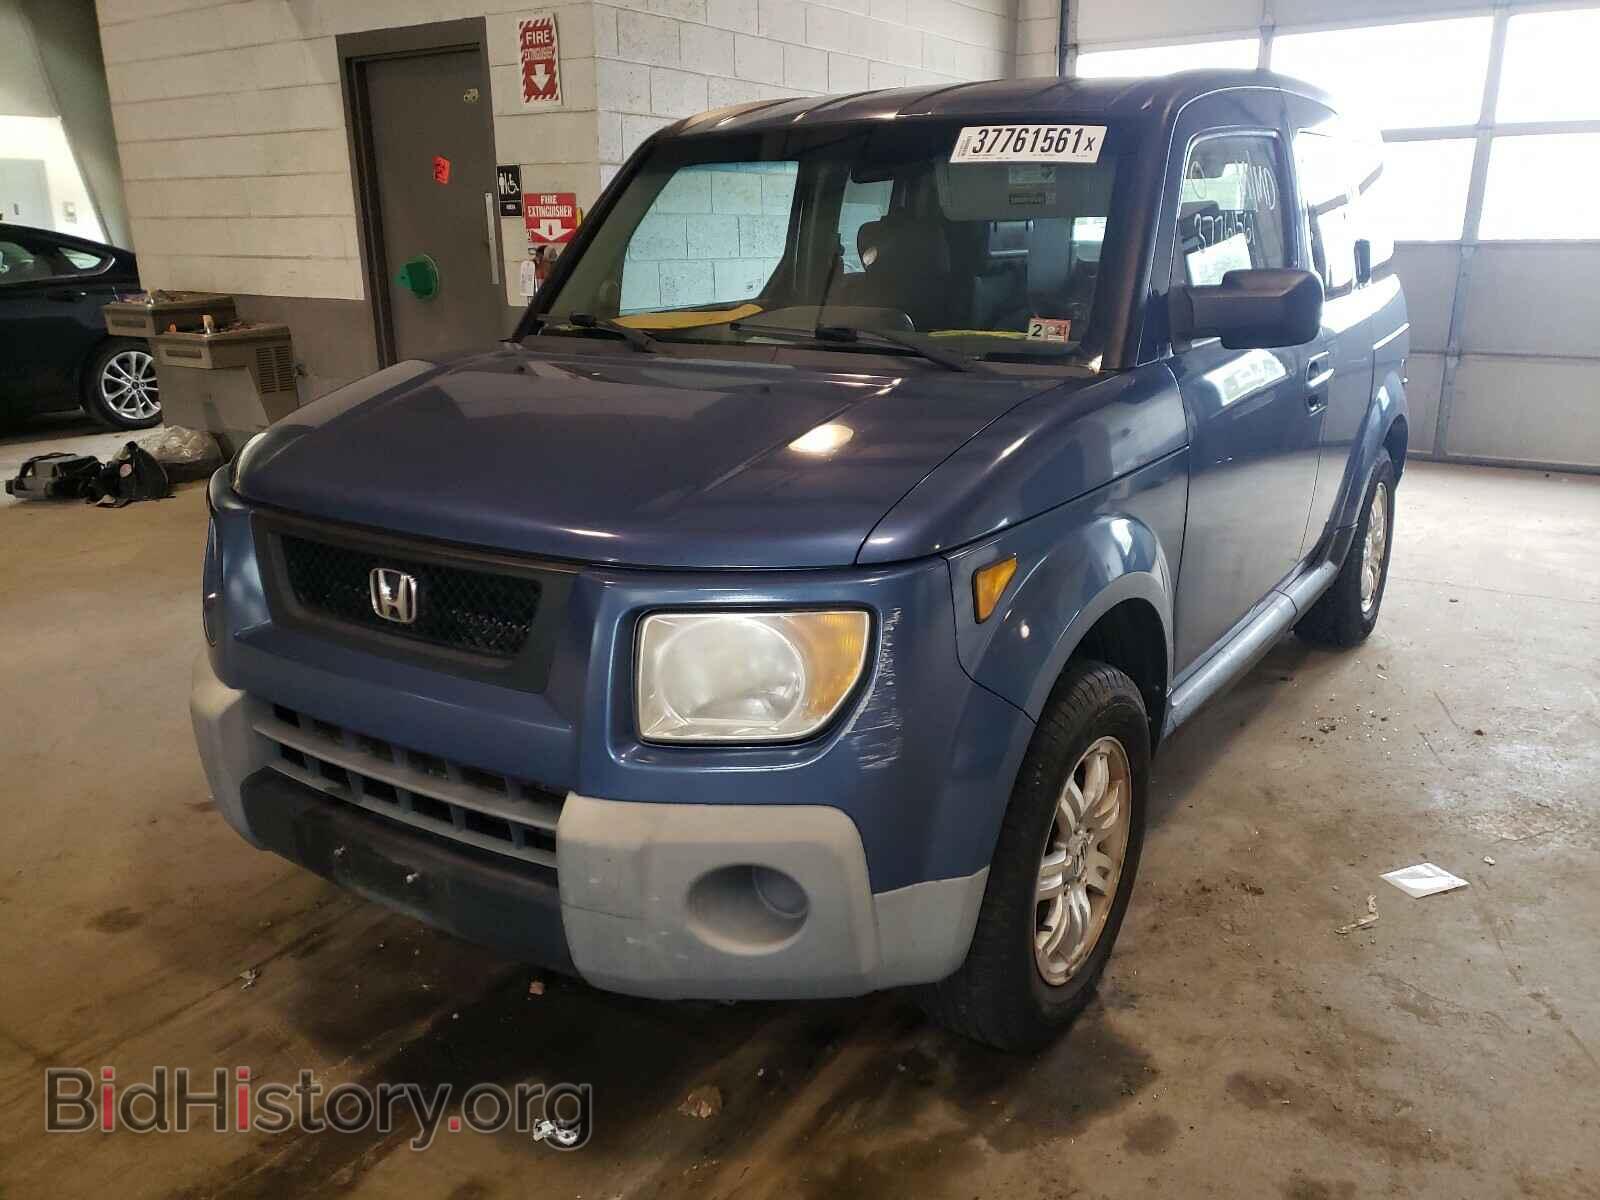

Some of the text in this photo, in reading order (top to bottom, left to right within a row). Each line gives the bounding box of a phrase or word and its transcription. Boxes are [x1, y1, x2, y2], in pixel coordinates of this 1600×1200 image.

[525, 29, 551, 45] FIRE
[540, 194, 558, 205] FIRE
[527, 205, 573, 217] EXTINGUISHER
